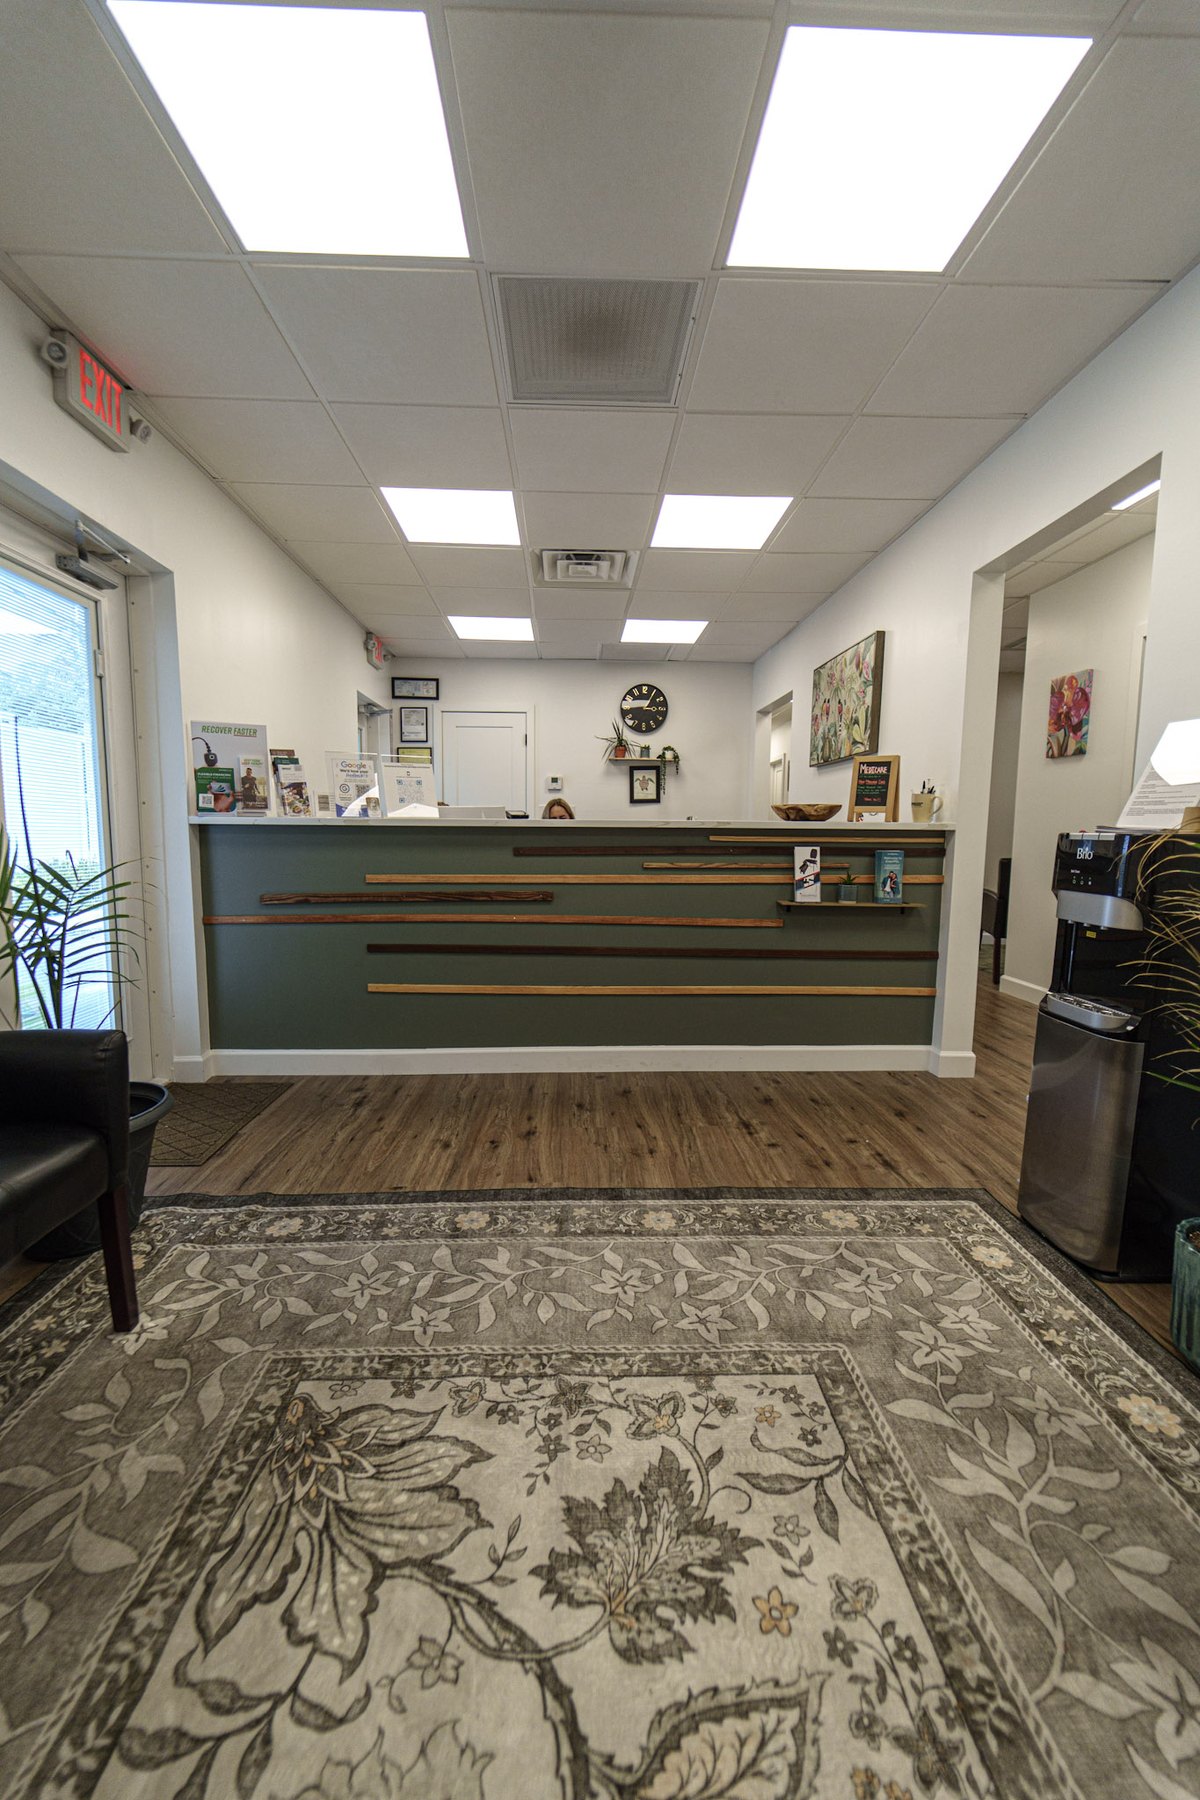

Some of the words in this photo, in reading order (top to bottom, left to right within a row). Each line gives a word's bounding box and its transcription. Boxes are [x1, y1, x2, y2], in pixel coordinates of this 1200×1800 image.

[80, 347, 123, 436] EXIT
[201, 725, 233, 735] RECOVER
[233, 727, 257, 738] FASTER
[340, 760, 367, 770] Google
[860, 763, 888, 774] MEDICARE
[1076, 847, 1094, 860] Brio
